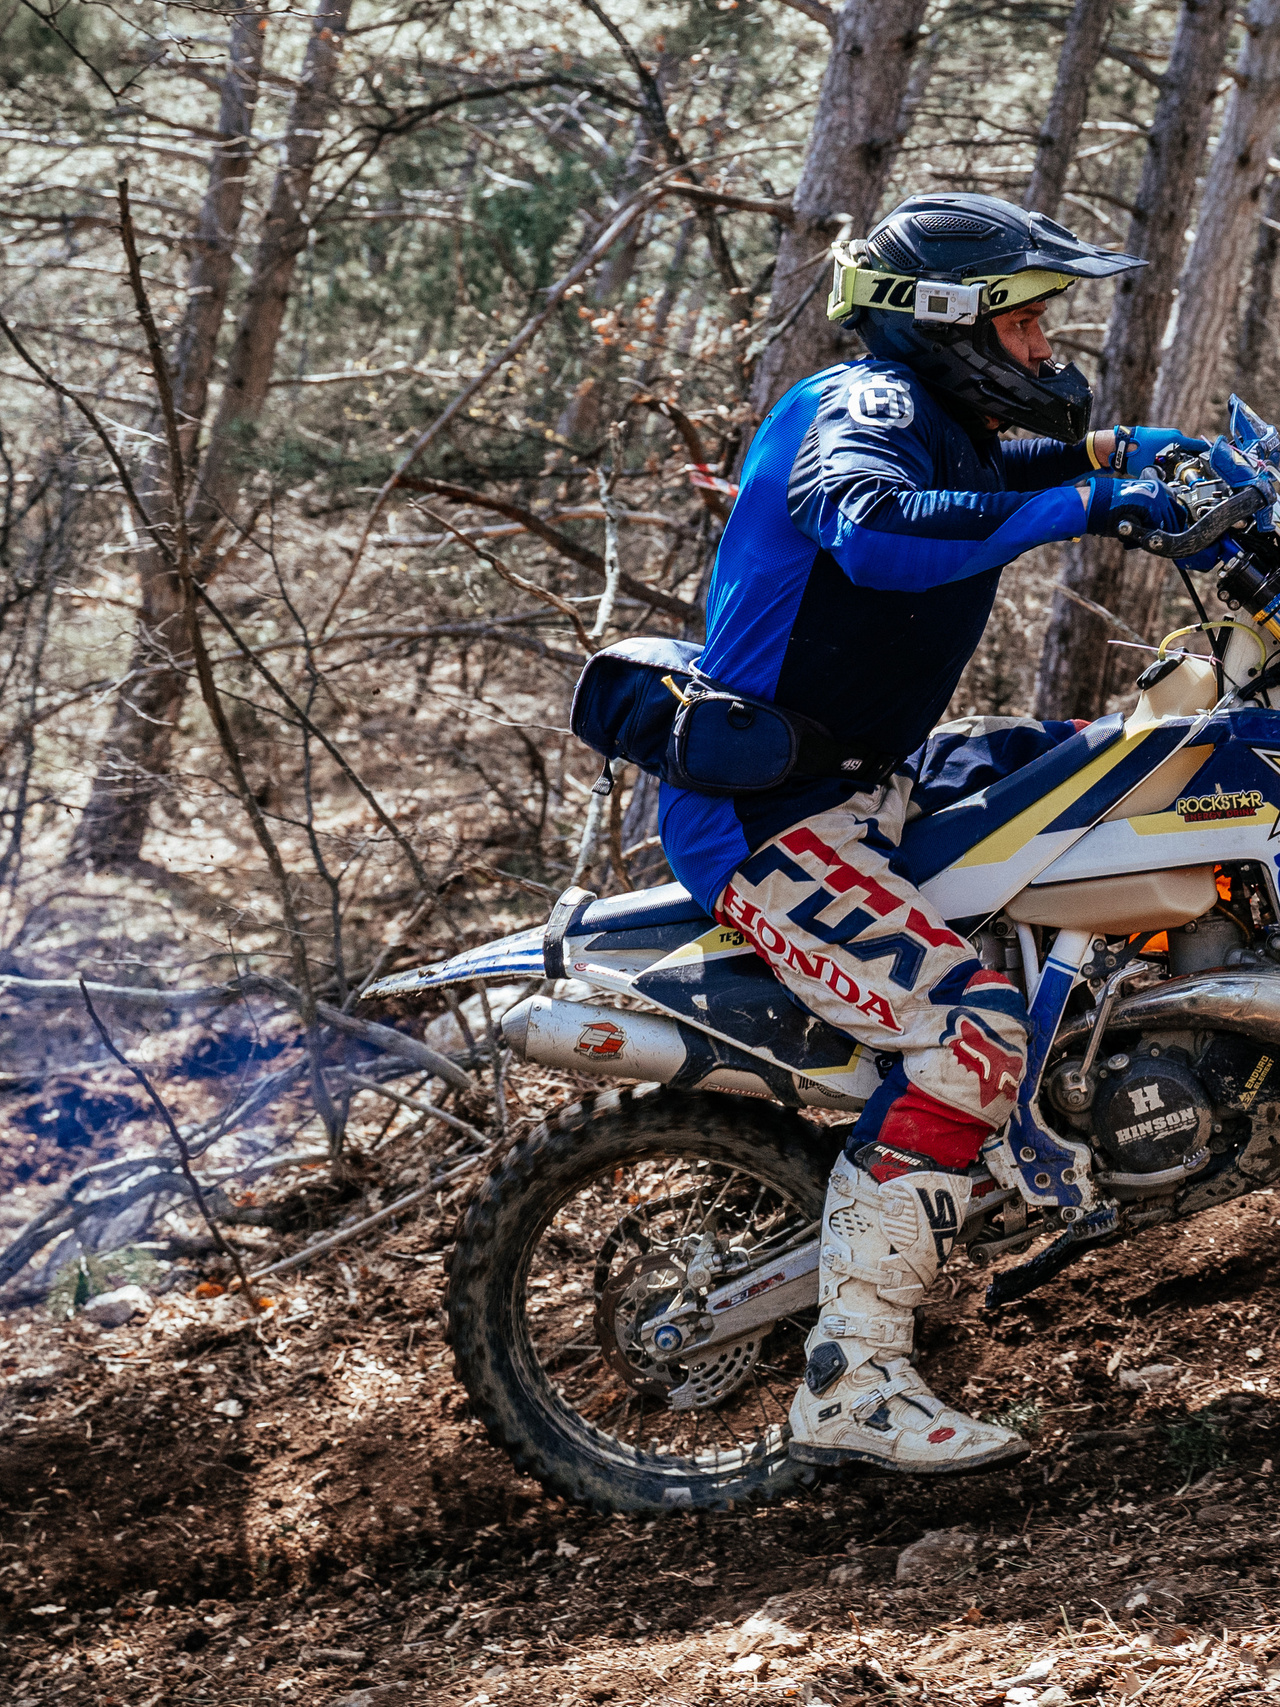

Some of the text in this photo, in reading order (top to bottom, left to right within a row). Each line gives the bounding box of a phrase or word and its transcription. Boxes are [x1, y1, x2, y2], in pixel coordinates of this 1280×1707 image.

[1184, 807, 1257, 822] ENERGY DRINK
[719, 930, 751, 946] TE3
[723, 881, 904, 1035] HONDA
[1244, 1054, 1270, 1089] ENDURO
[1253, 1058, 1275, 1090] ELEMENT
[1128, 1082, 1165, 1117] H
[1115, 1107, 1196, 1143] HINSON
